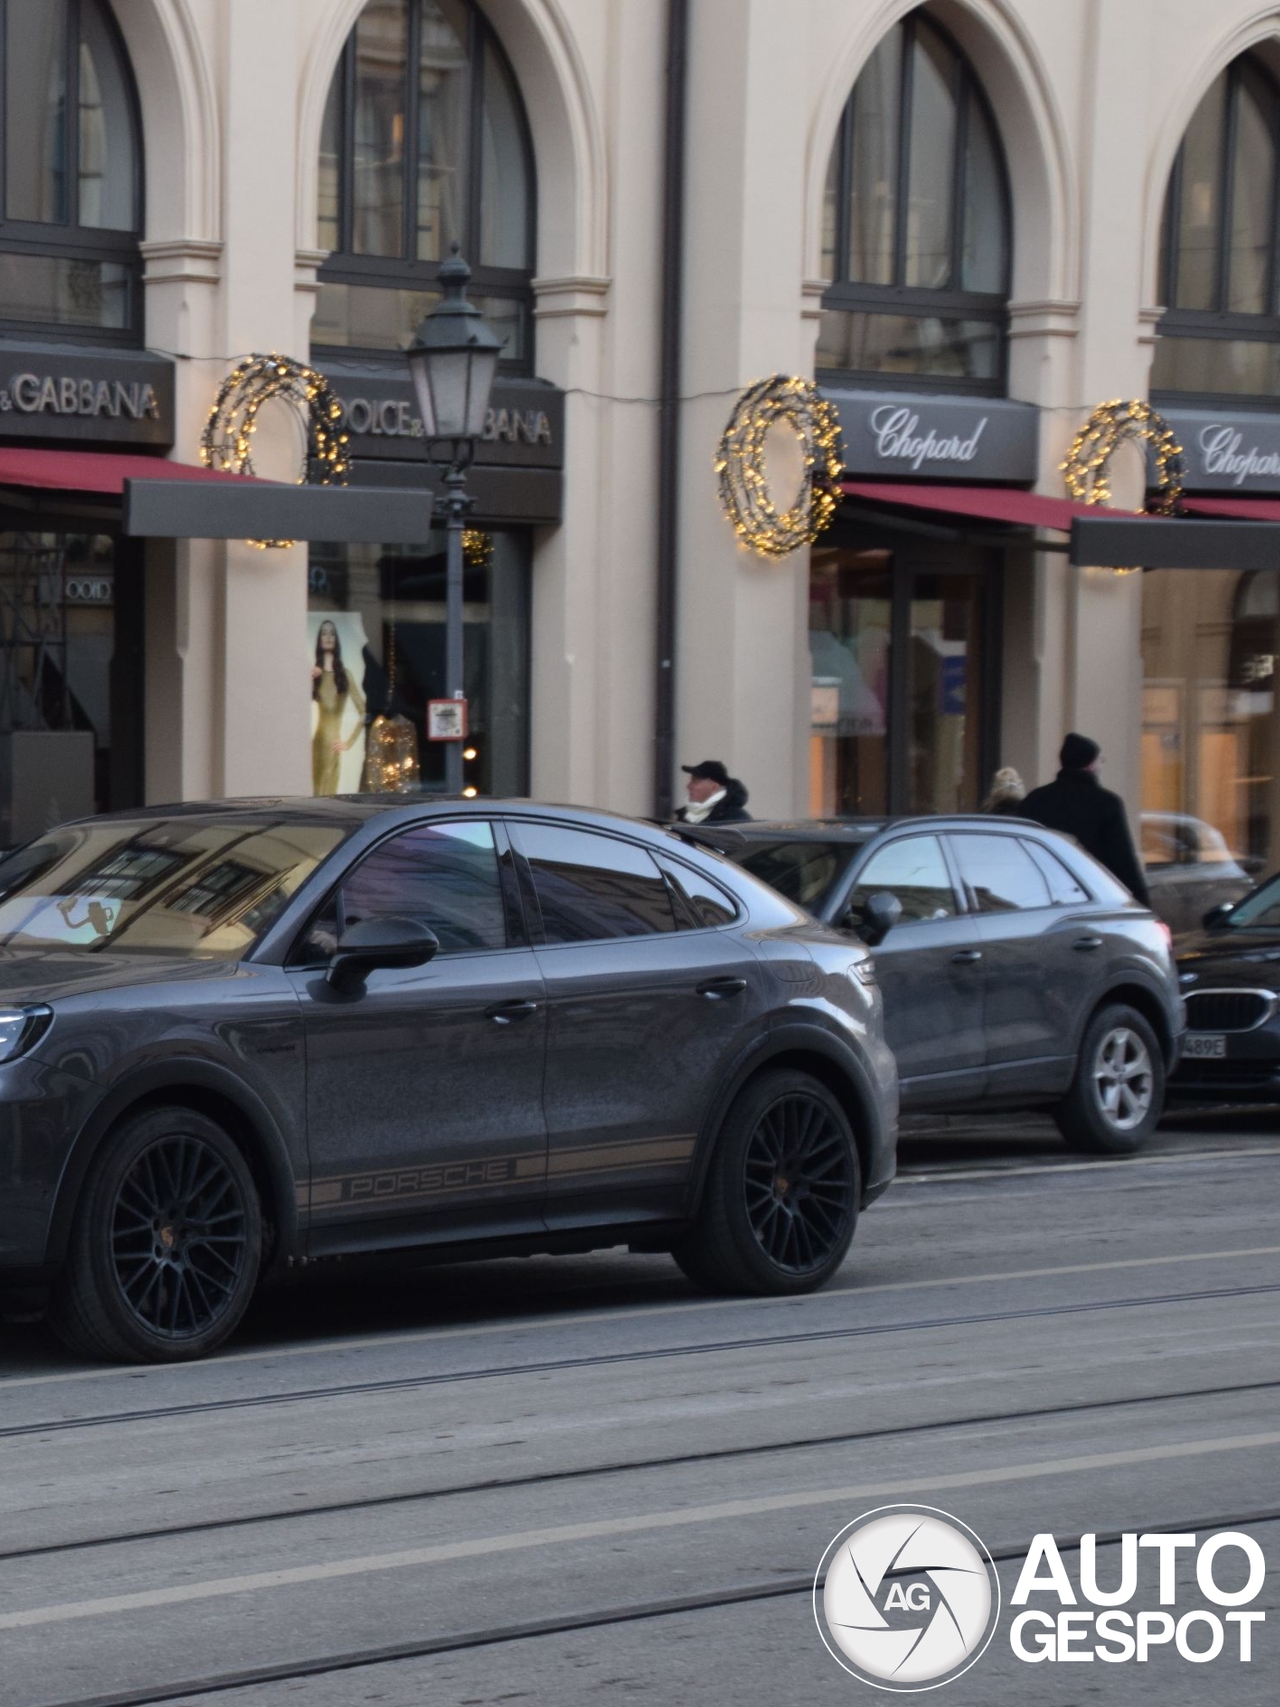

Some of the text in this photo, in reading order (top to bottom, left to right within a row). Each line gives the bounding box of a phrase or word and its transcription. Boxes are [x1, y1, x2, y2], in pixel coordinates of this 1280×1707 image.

[871, 405, 988, 470] Chopard
[1200, 424, 1280, 487] Chopar
[349, 1160, 509, 1198] PORSCHE
